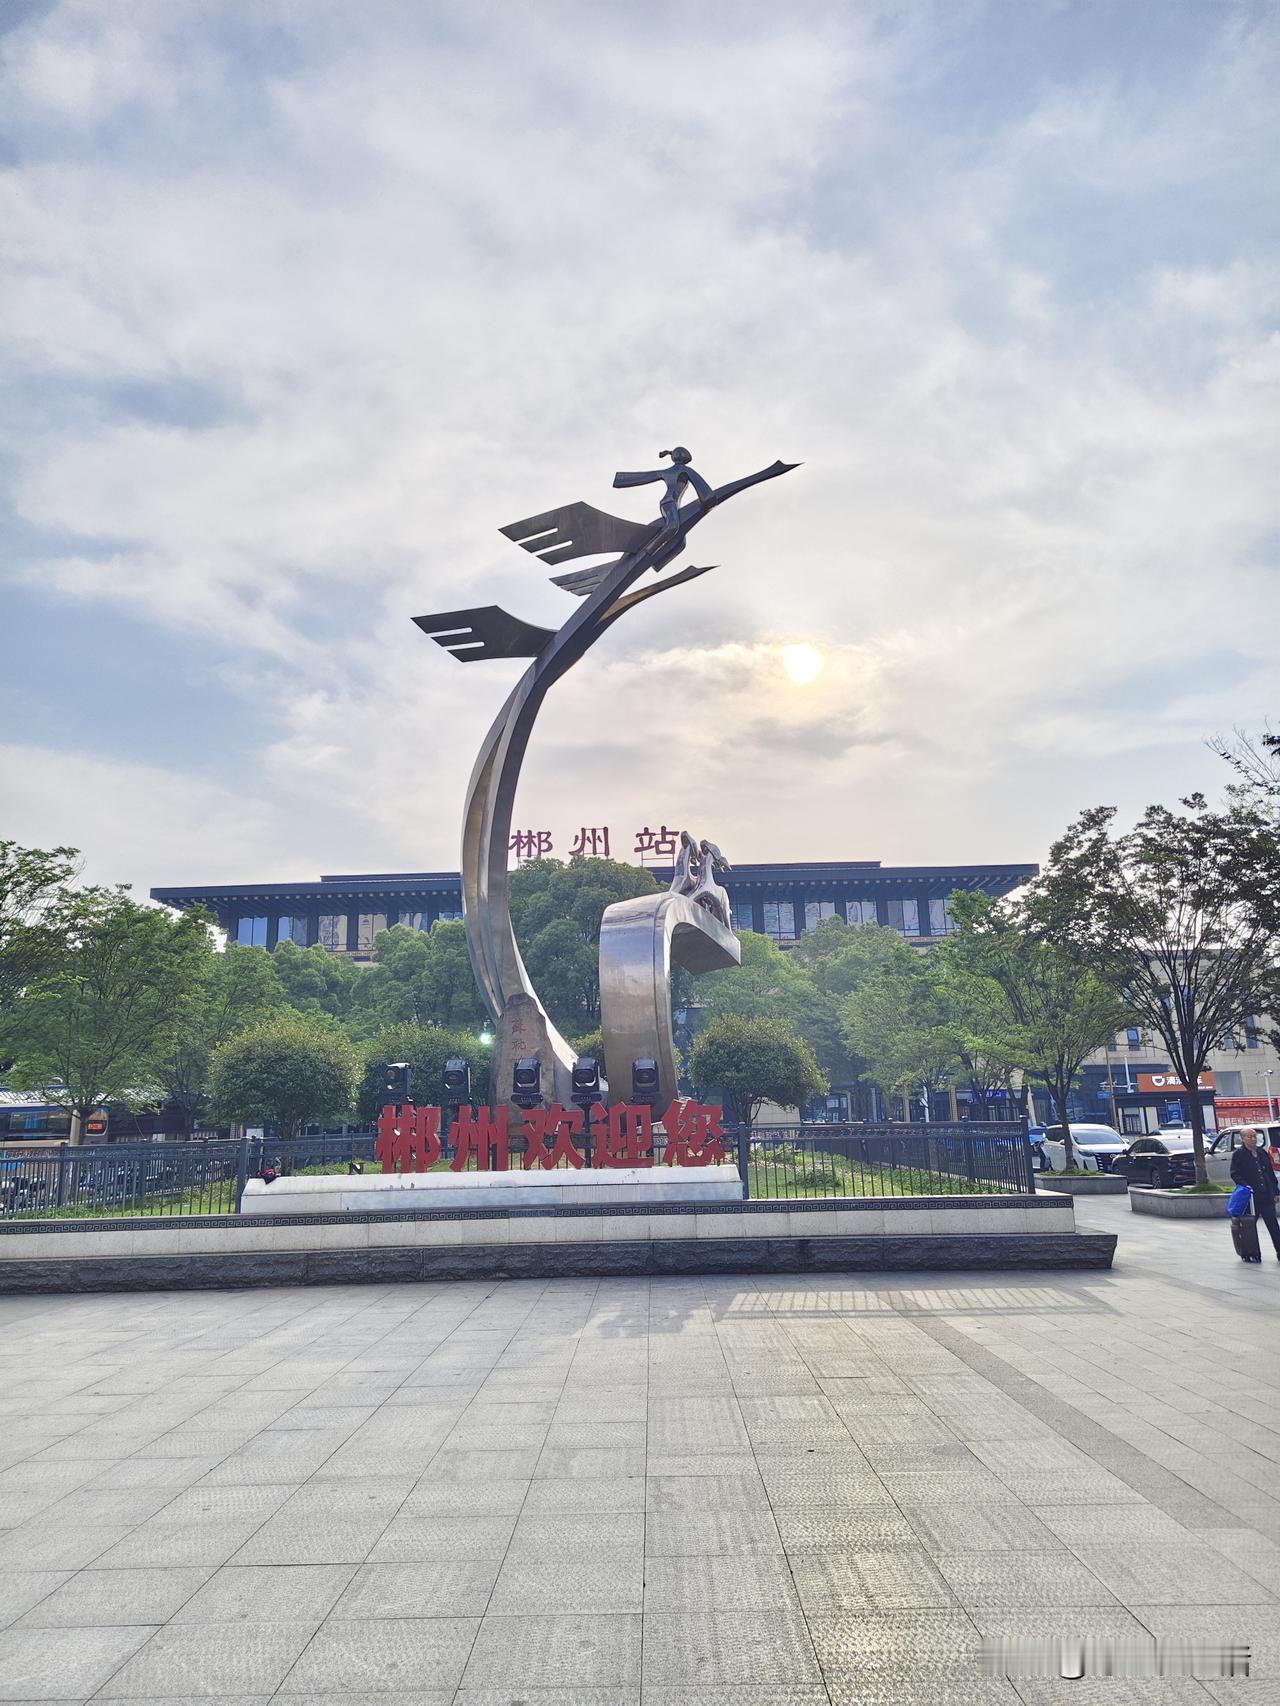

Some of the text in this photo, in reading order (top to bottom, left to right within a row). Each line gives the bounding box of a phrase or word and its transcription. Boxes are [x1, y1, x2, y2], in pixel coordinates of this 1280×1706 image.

[509, 825, 680, 857] 郴州站
[375, 1099, 726, 1174] 郴州欢迎您
